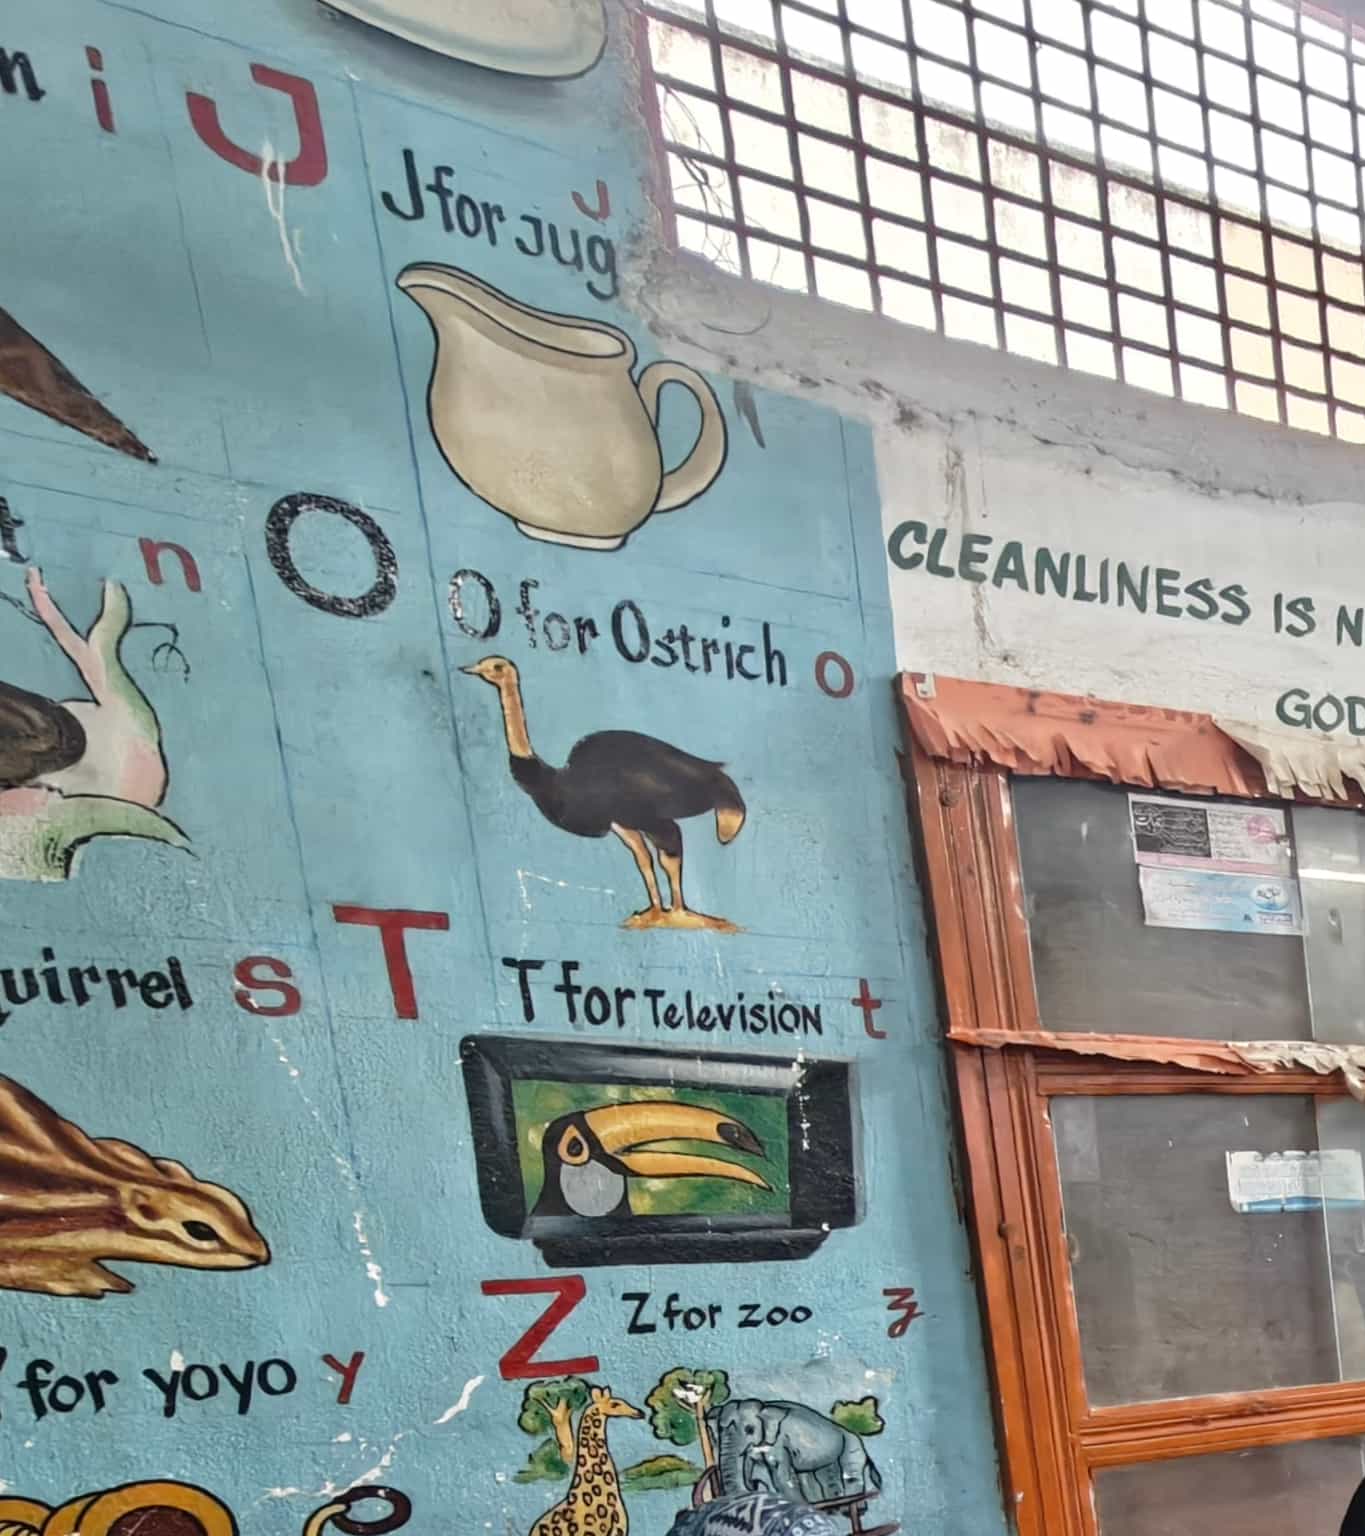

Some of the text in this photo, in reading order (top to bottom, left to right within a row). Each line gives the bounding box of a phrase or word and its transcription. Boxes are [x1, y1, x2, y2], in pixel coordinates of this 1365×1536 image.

[186, 63, 328, 187] J
[380, 148, 424, 222] J
[426, 165, 506, 246] for
[138, 537, 202, 593] n
[264, 491, 399, 620] O
[887, 519, 1252, 626] CLEANLINESS
[1274, 592, 1317, 638] IS
[449, 568, 789, 688] O for Ostrich
[332, 904, 450, 1021] T
[502, 958, 544, 1024] T
[554, 960, 637, 1028] for
[481, 1274, 600, 1381] Z
[620, 1292, 815, 1335] Z for zoo
[16, 1359, 119, 1422] for
[143, 1357, 297, 1418] yoyo
